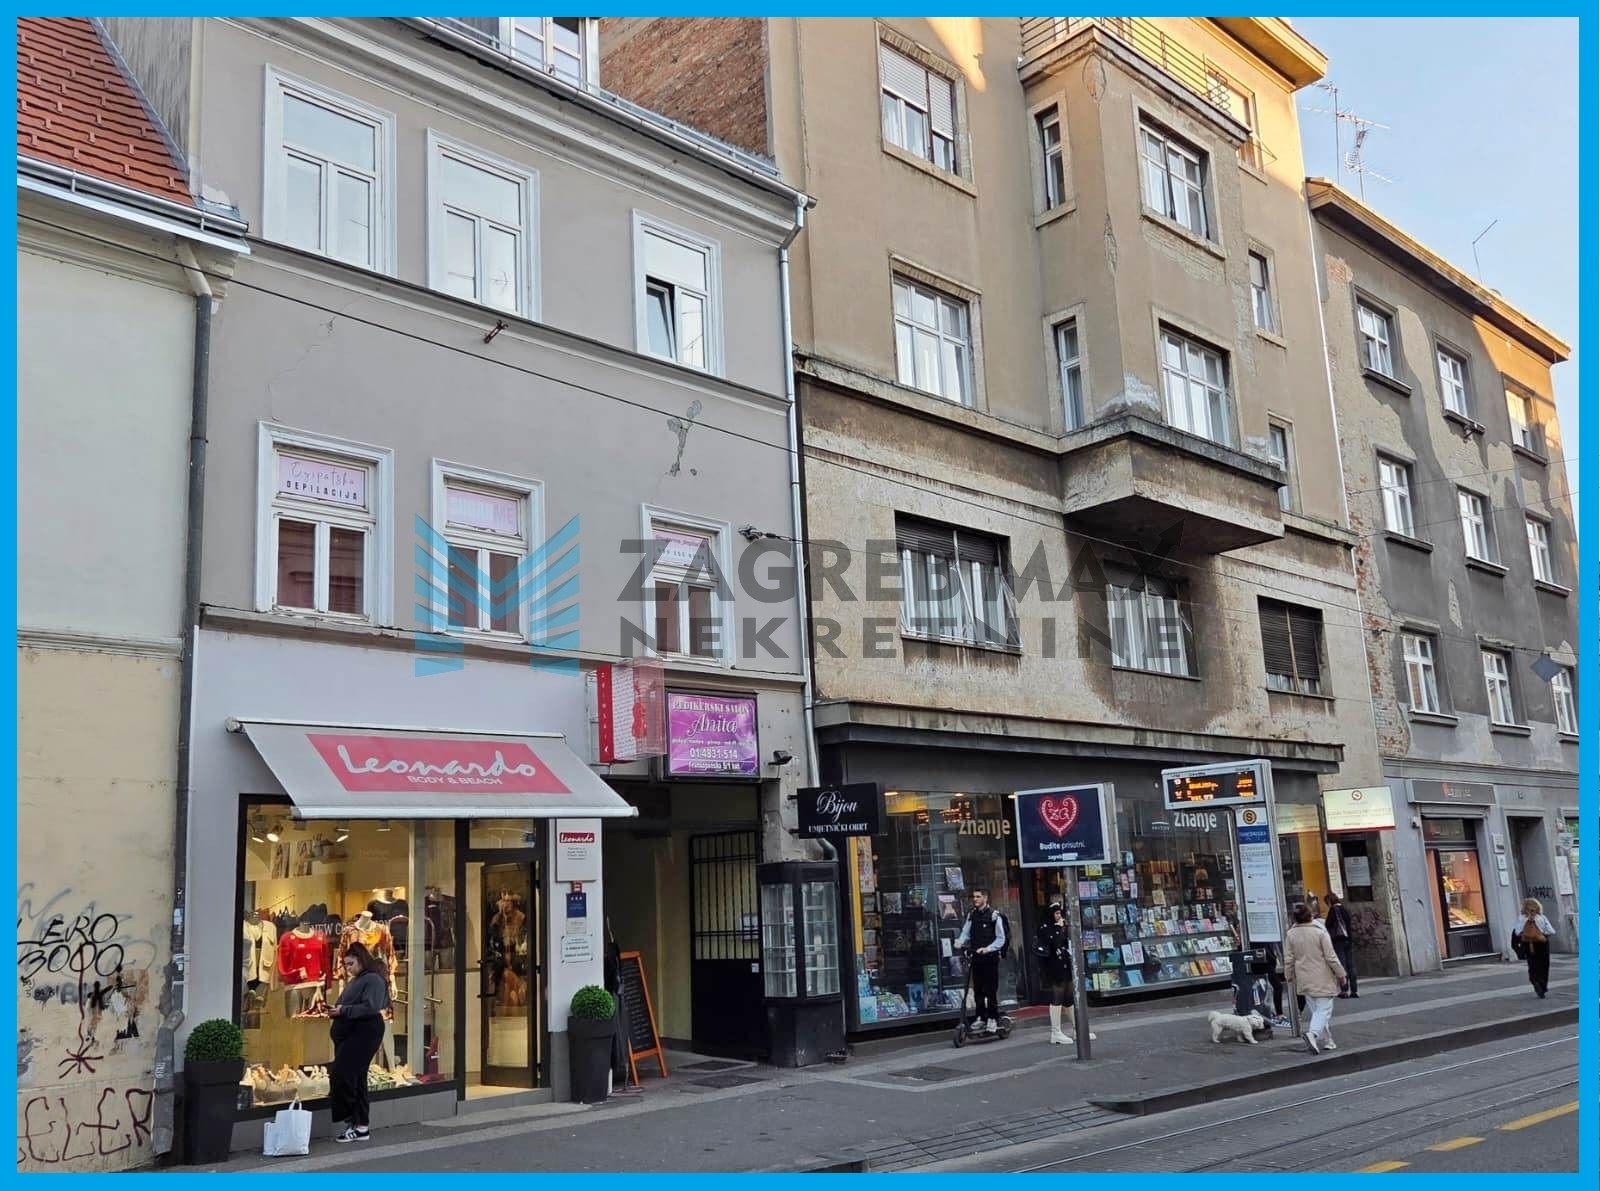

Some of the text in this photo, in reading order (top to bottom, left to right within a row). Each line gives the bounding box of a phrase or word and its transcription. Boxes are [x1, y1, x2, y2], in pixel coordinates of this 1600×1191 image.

[286, 480, 358, 500] DEPILACIJA
[672, 700, 750, 713] PEDIKERSKI SALON
[686, 713, 737, 737] Anita
[336, 744, 536, 777] Leonardo
[407, 775, 504, 786] BODY & BEACH
[816, 790, 858, 823] Bijou
[959, 819, 1011, 839] znanje
[1173, 811, 1217, 832] znanje
[1039, 842, 1060, 850] Budite
[18, 943, 124, 981] 3000
